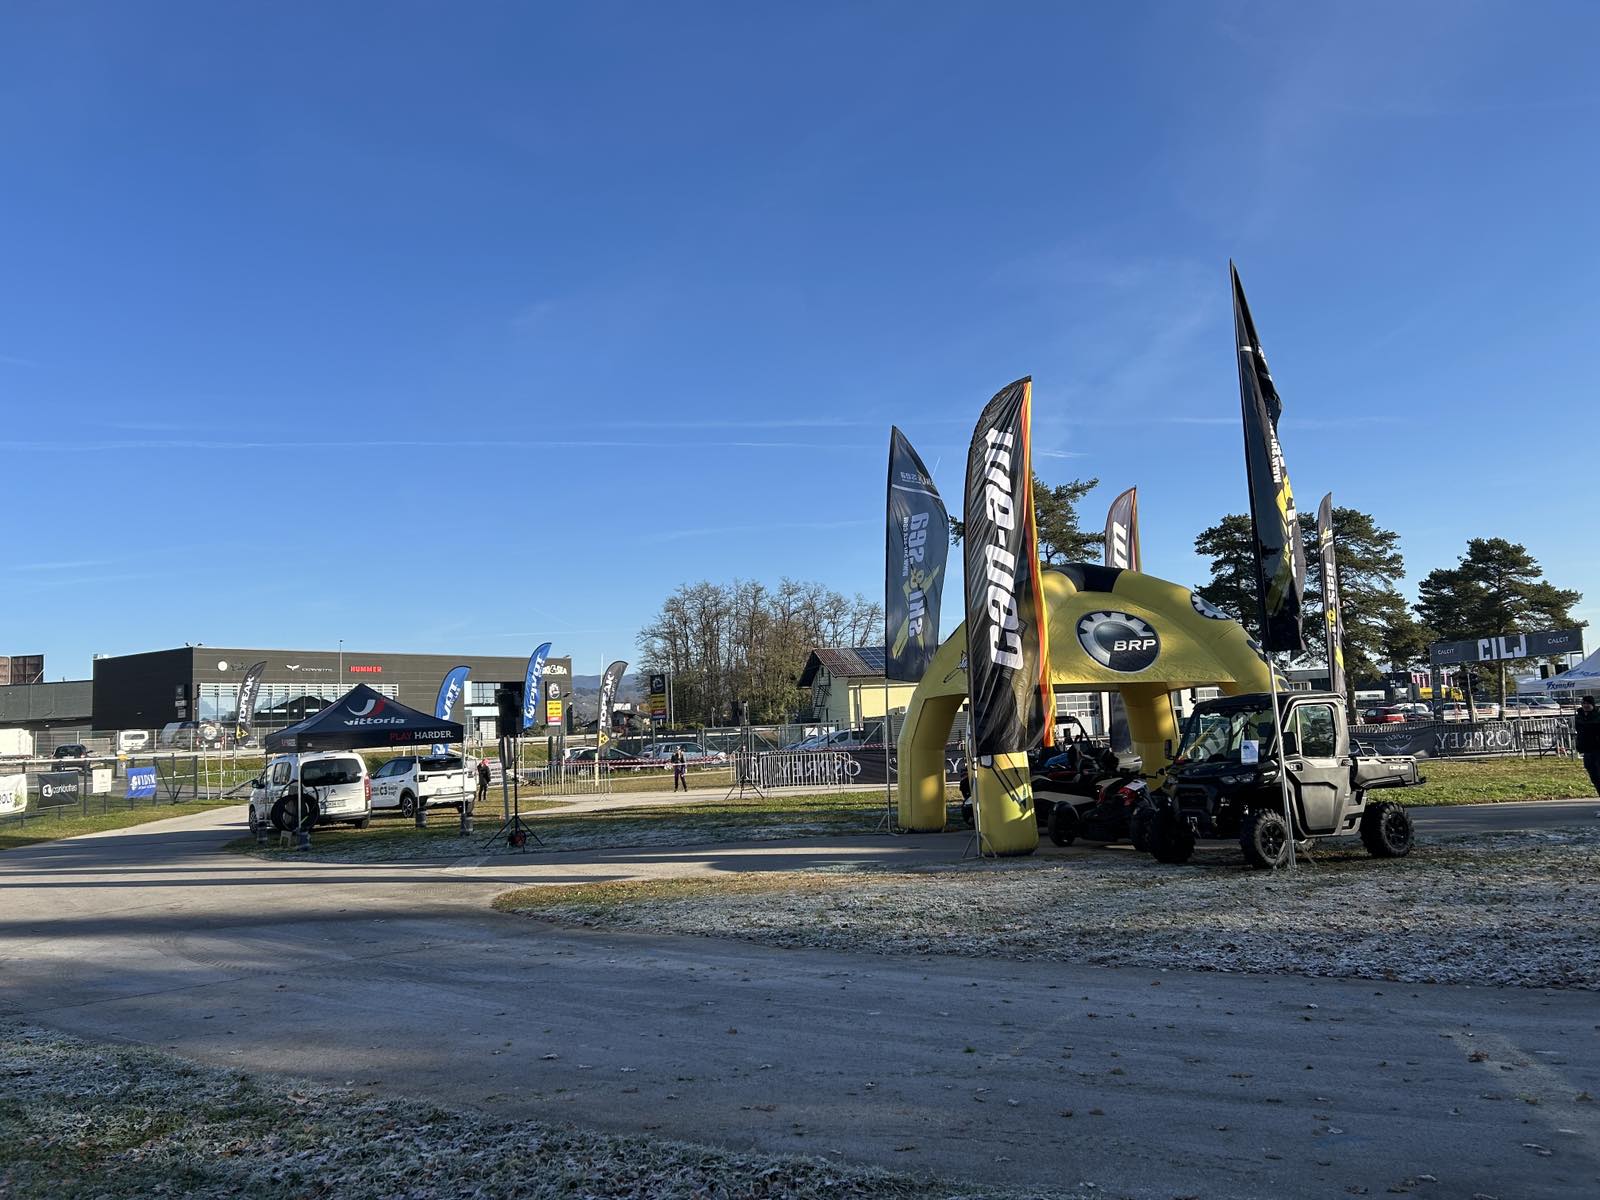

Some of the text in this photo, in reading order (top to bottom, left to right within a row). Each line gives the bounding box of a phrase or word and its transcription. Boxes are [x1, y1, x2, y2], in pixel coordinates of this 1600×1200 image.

[984, 427, 1024, 670] can-am
[1113, 639, 1157, 652] BRP
[1548, 636, 1569, 644] CALCIT
[1477, 634, 1527, 661] CILJ
[350, 665, 382, 673] HUMMER
[237, 676, 255, 724] TOPEAK
[600, 673, 615, 729] TOPEAK
[343, 716, 406, 726] vittoria
[390, 730, 454, 741] PLAY HARDER.
